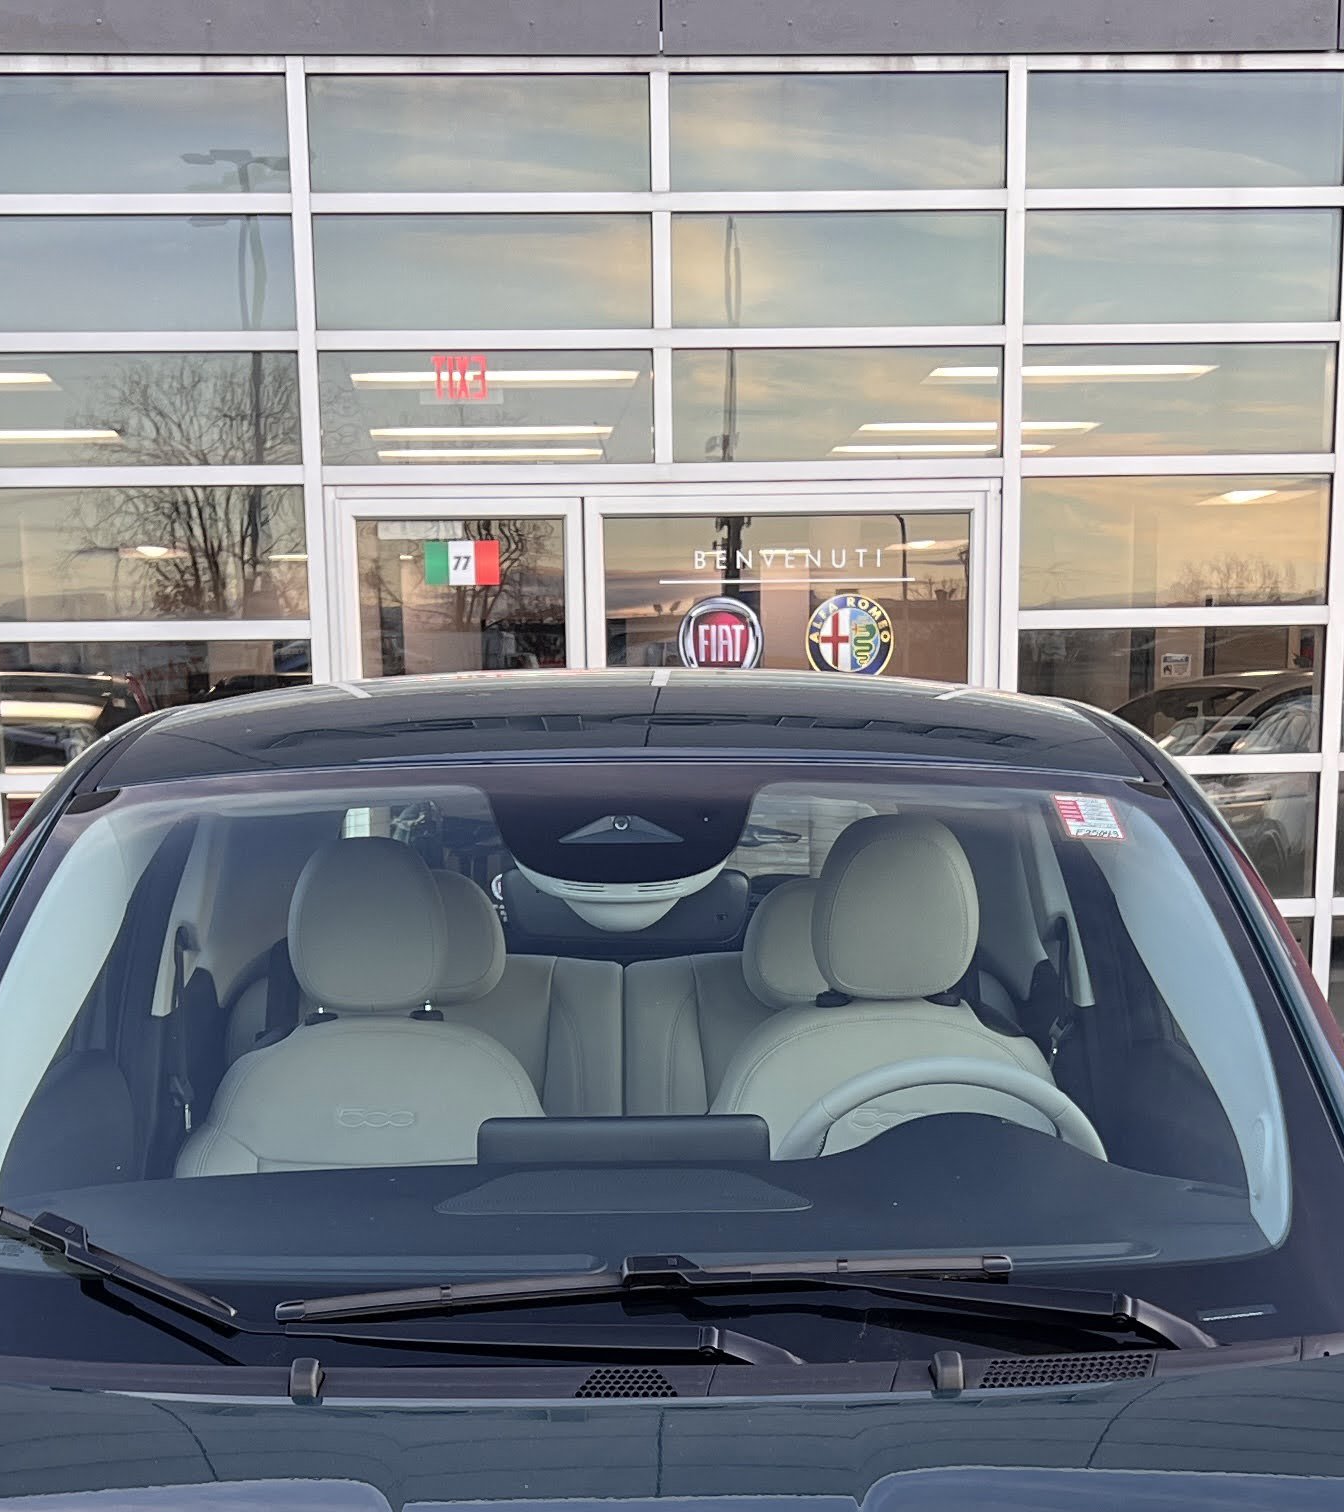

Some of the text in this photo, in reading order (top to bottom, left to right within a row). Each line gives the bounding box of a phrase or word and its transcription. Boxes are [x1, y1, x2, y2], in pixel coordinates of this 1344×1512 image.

[452, 555, 471, 571] 77
[693, 548, 882, 570] BENVENUTI
[809, 596, 892, 644] ALFA ROMEO
[697, 624, 746, 663] FIAT
[336, 1107, 416, 1128] 500
[850, 1107, 926, 1129] 50
